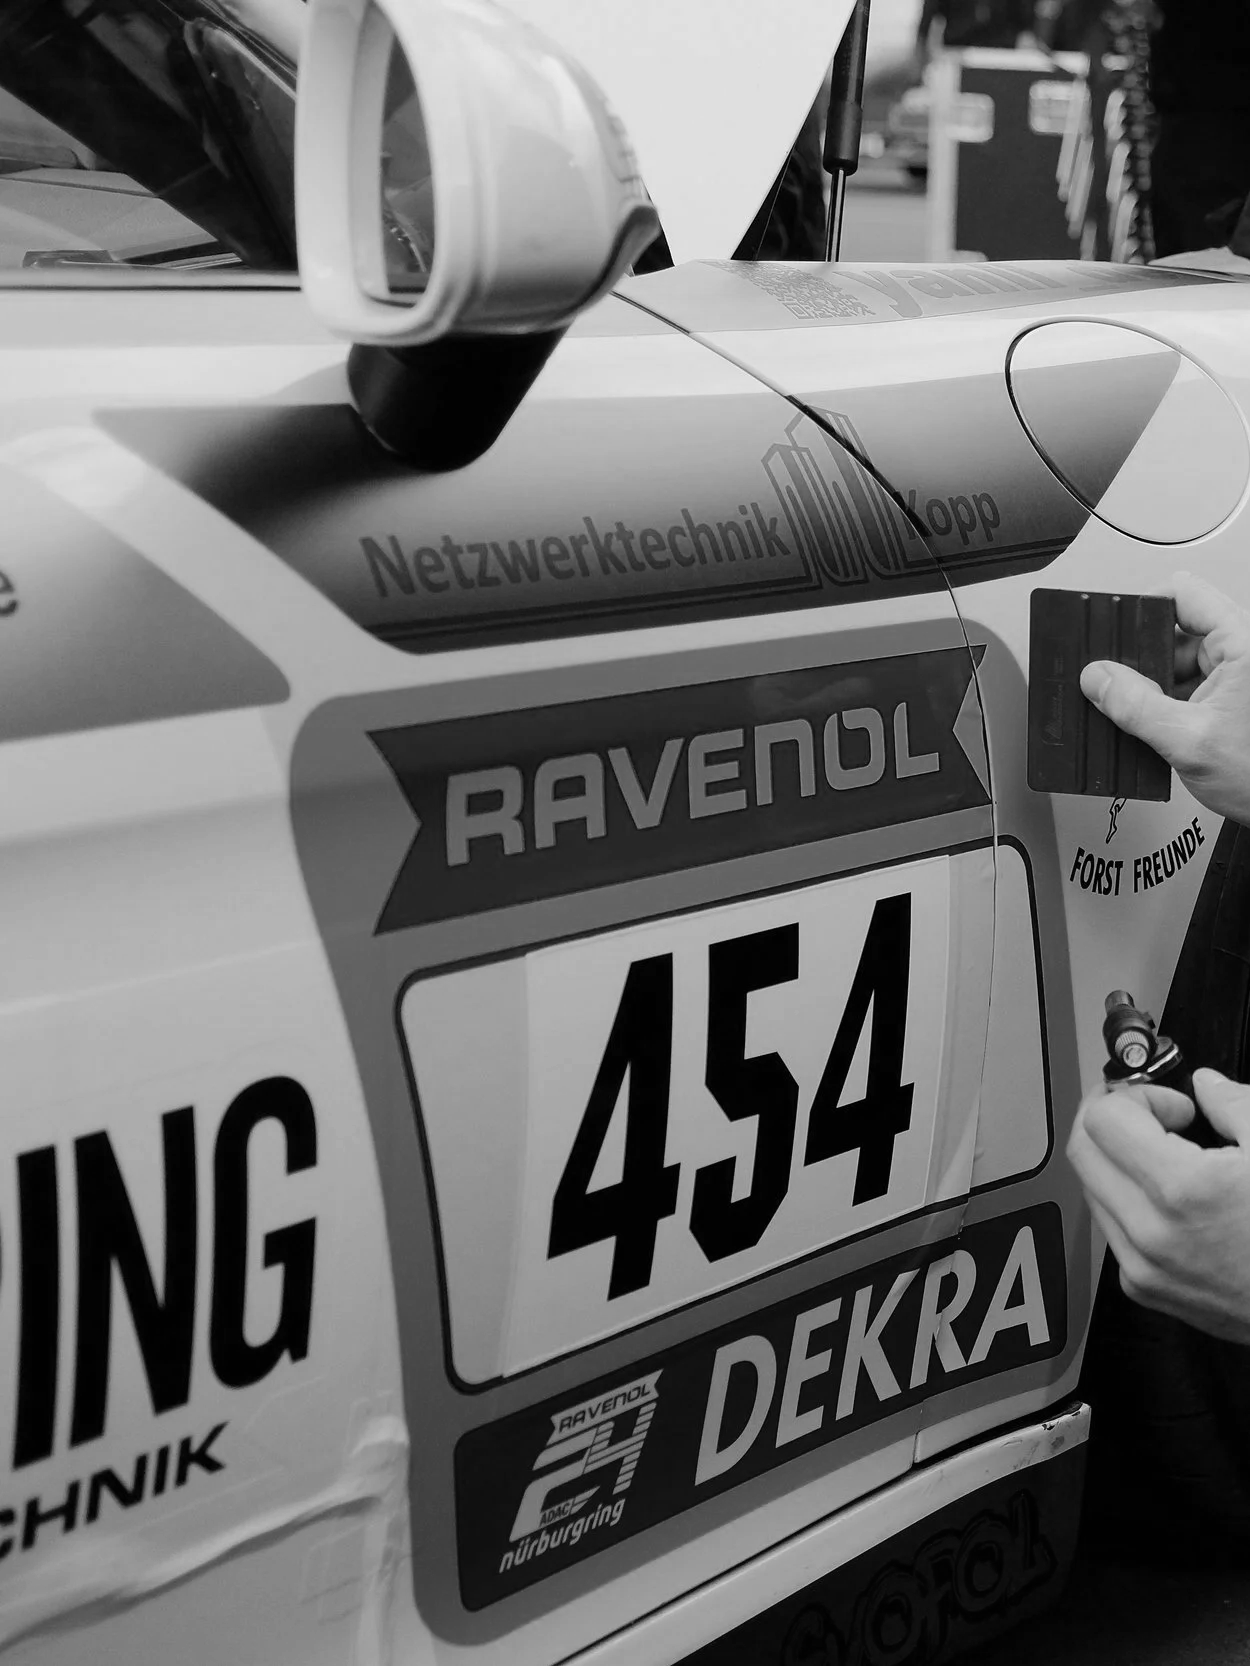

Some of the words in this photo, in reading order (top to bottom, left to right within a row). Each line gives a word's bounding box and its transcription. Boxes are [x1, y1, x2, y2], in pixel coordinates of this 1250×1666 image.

[359, 502, 791, 598] Netzwerktechnik
[446, 702, 940, 867] RAVENOL
[1069, 846, 1124, 896] FORST
[1133, 816, 1206, 894] FREUNDE
[547, 891, 915, 1301] 454
[0, 1074, 318, 1471] ING
[694, 1225, 1051, 1487] DEKRA
[558, 1383, 651, 1434] RAVENOL
[499, 1498, 626, 1574] nürburgring
[539, 1502, 571, 1527] ADAC
